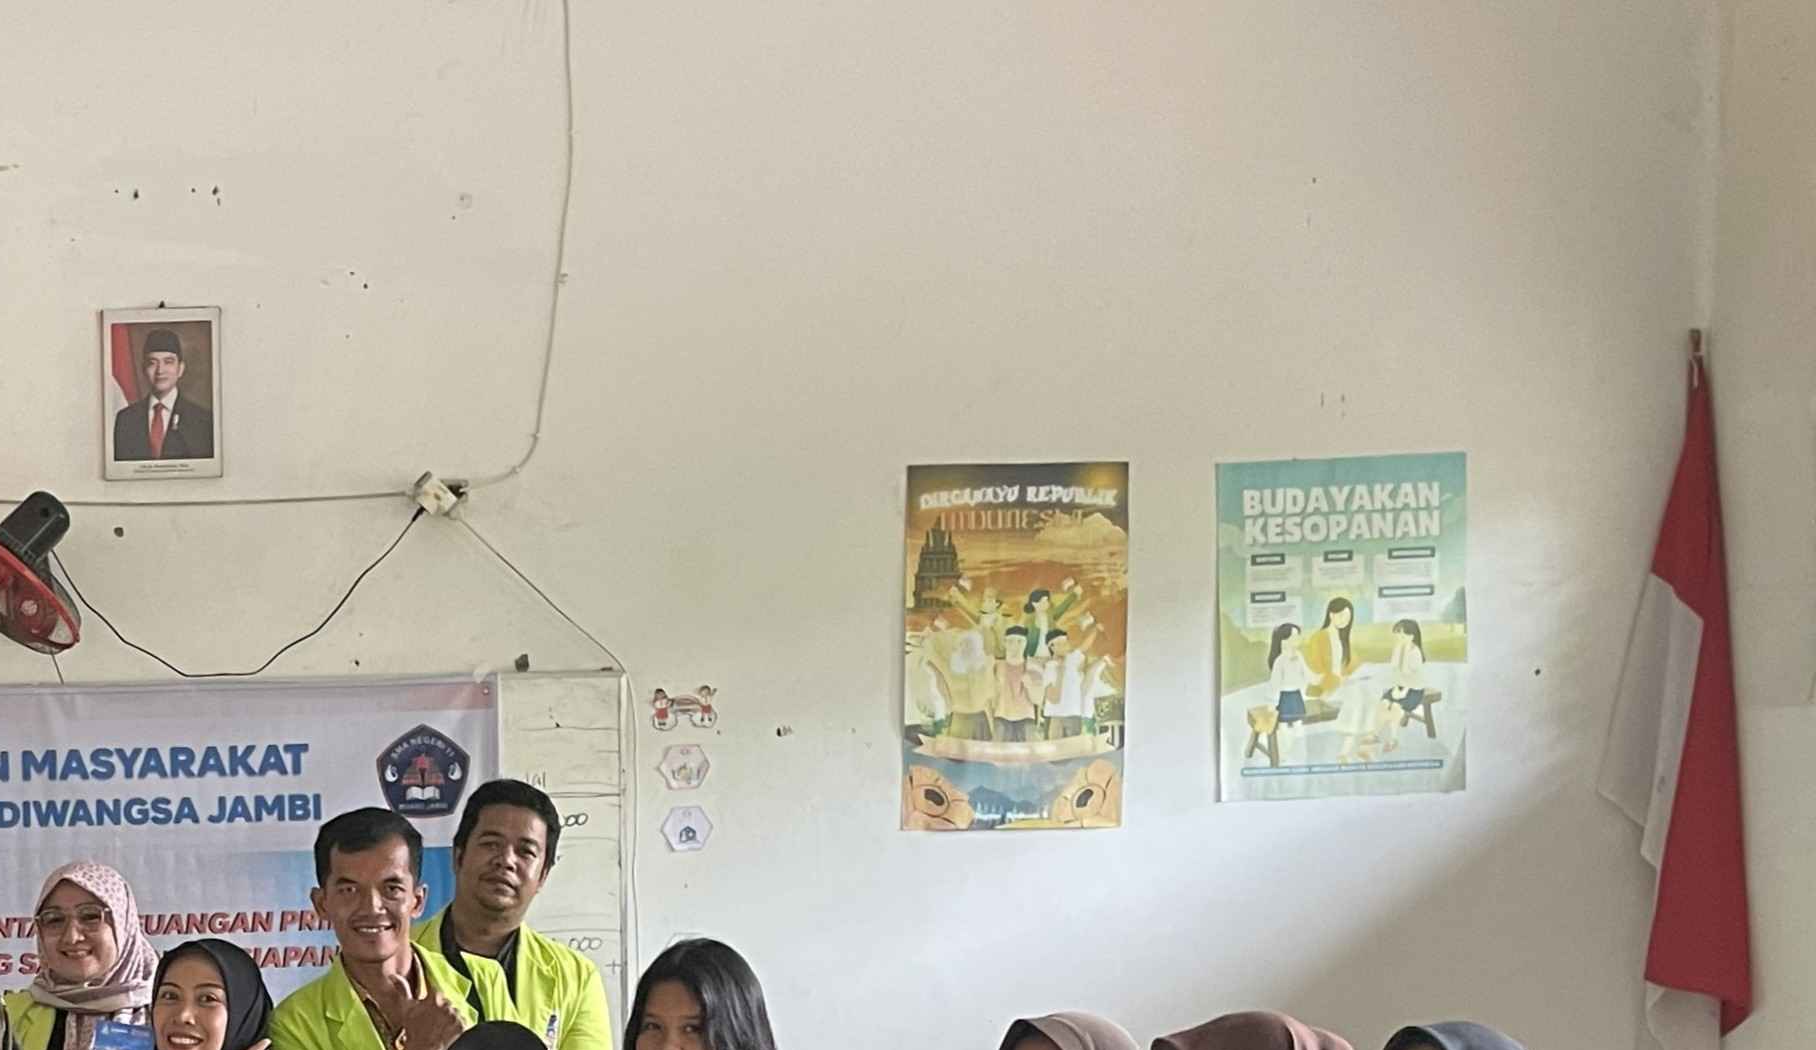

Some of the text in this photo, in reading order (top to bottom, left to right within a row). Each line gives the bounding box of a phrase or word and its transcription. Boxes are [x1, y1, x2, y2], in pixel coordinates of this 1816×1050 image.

[1243, 481, 1440, 516] BUDAYAKAN
[1244, 509, 1441, 544] KESOPANAN
[21, 743, 310, 782] MASYARAKAT
[207, 793, 323, 824] JAMBI
